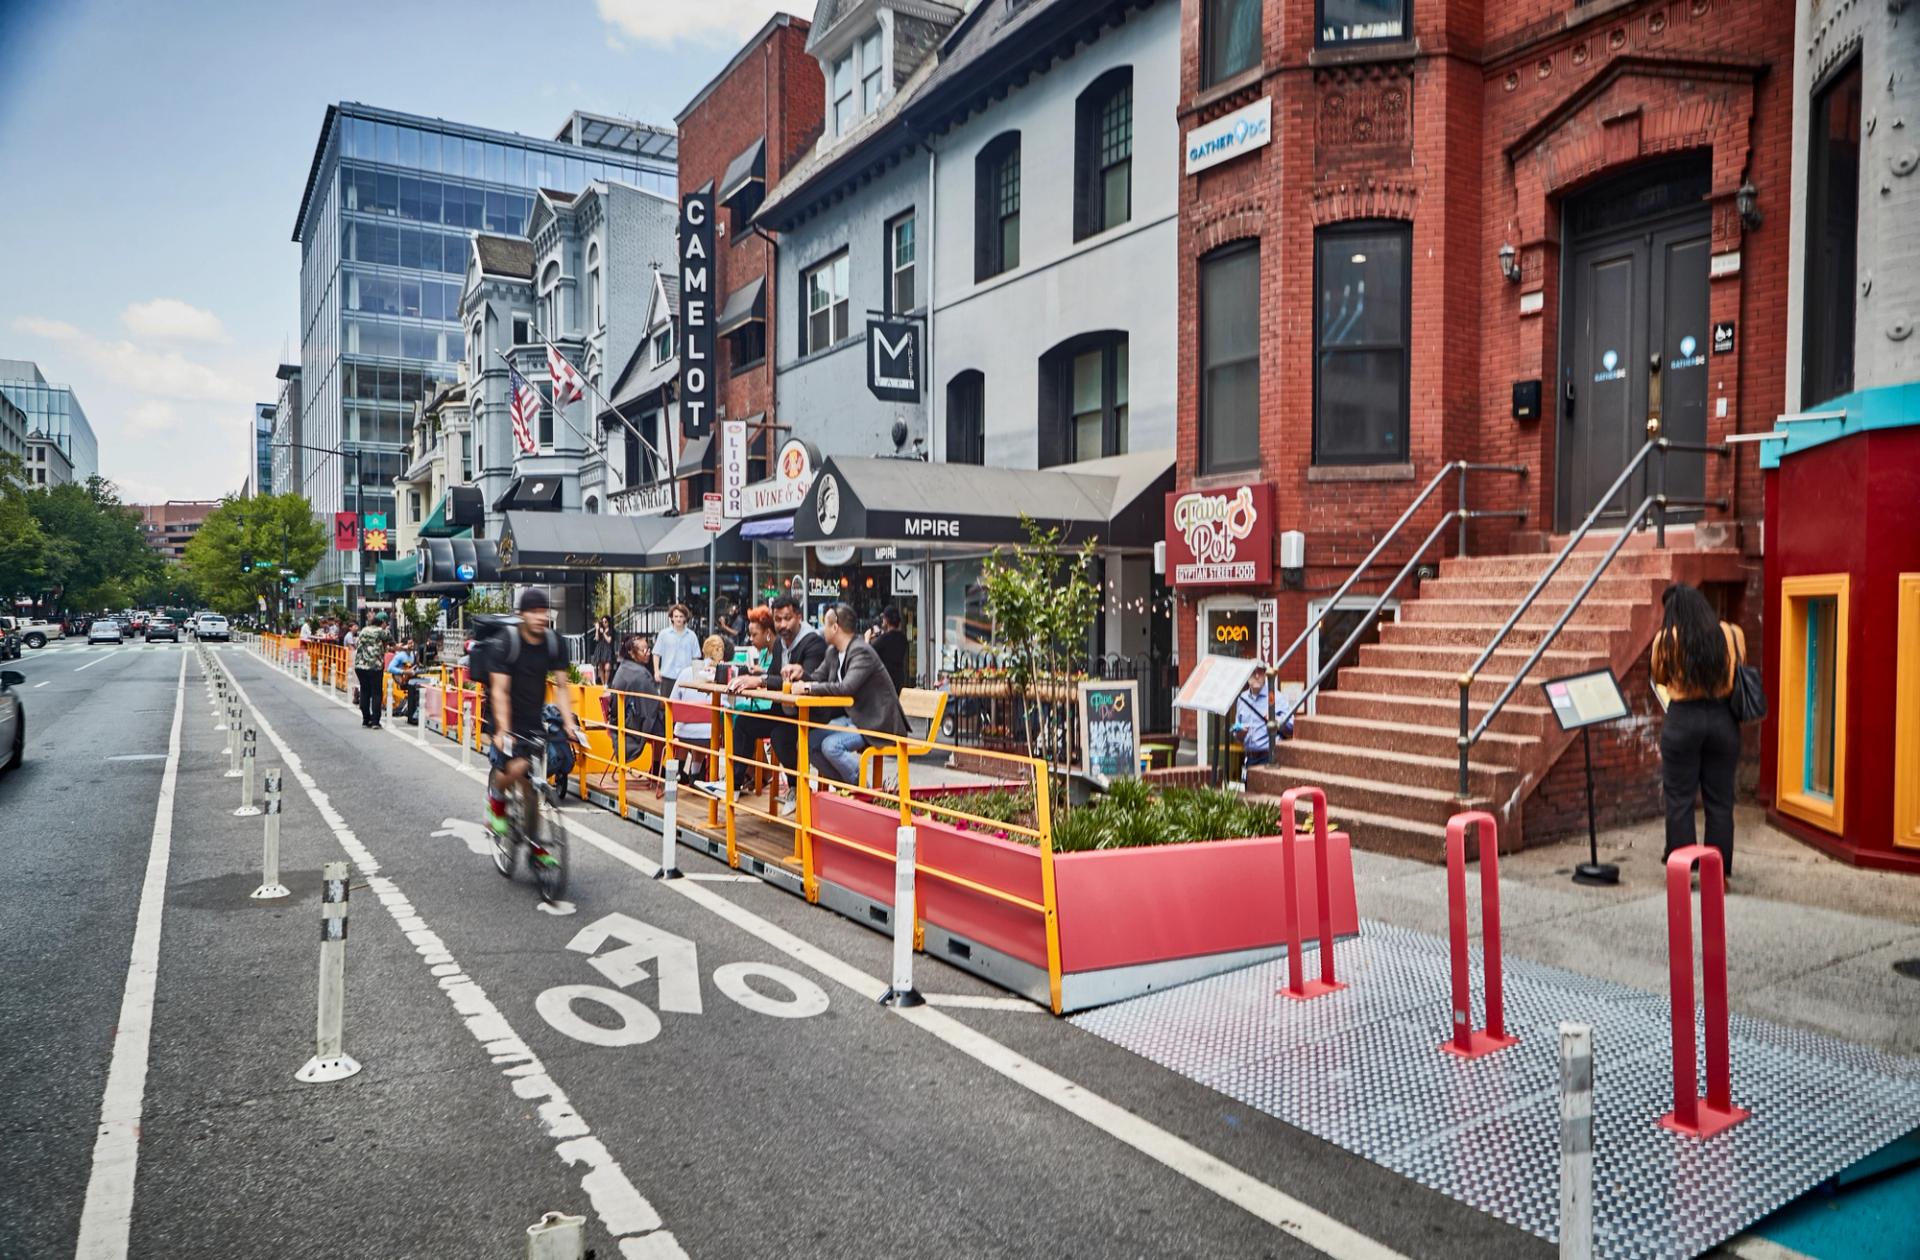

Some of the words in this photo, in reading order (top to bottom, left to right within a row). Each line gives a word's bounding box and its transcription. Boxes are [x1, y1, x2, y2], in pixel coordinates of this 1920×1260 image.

[1190, 133, 1234, 161] GATHER
[1249, 117, 1266, 138] DC
[685, 200, 707, 427] CAMELOT
[729, 437, 740, 511] LIQUOR
[905, 518, 960, 536] MPIRE
[1190, 523, 1235, 565] Pot
[1210, 567, 1233, 579] STREET
[1235, 565, 1255, 579] FOOD
[1216, 625, 1249, 645] open
